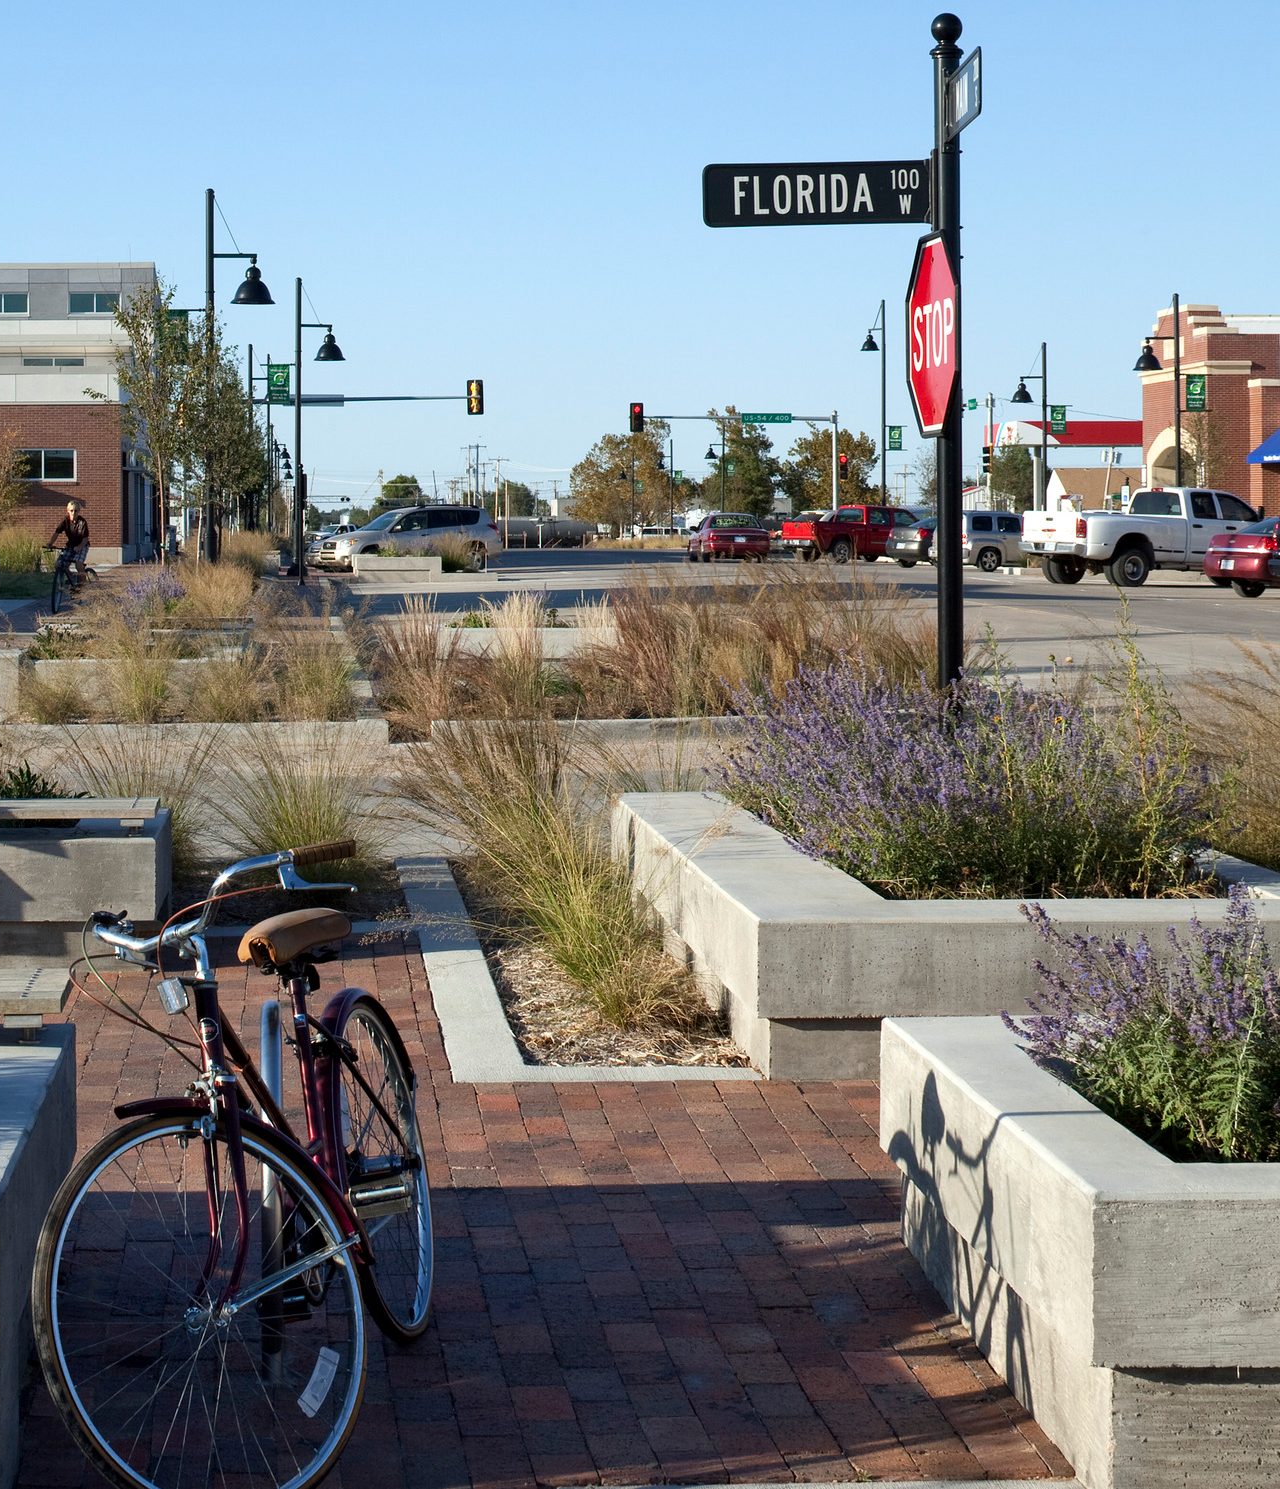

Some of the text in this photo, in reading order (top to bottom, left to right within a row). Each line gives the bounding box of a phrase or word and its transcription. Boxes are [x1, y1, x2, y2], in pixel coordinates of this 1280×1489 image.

[733, 168, 920, 216] FLORIDA 100
[899, 194, 912, 215] W
[913, 296, 955, 373] STOP
